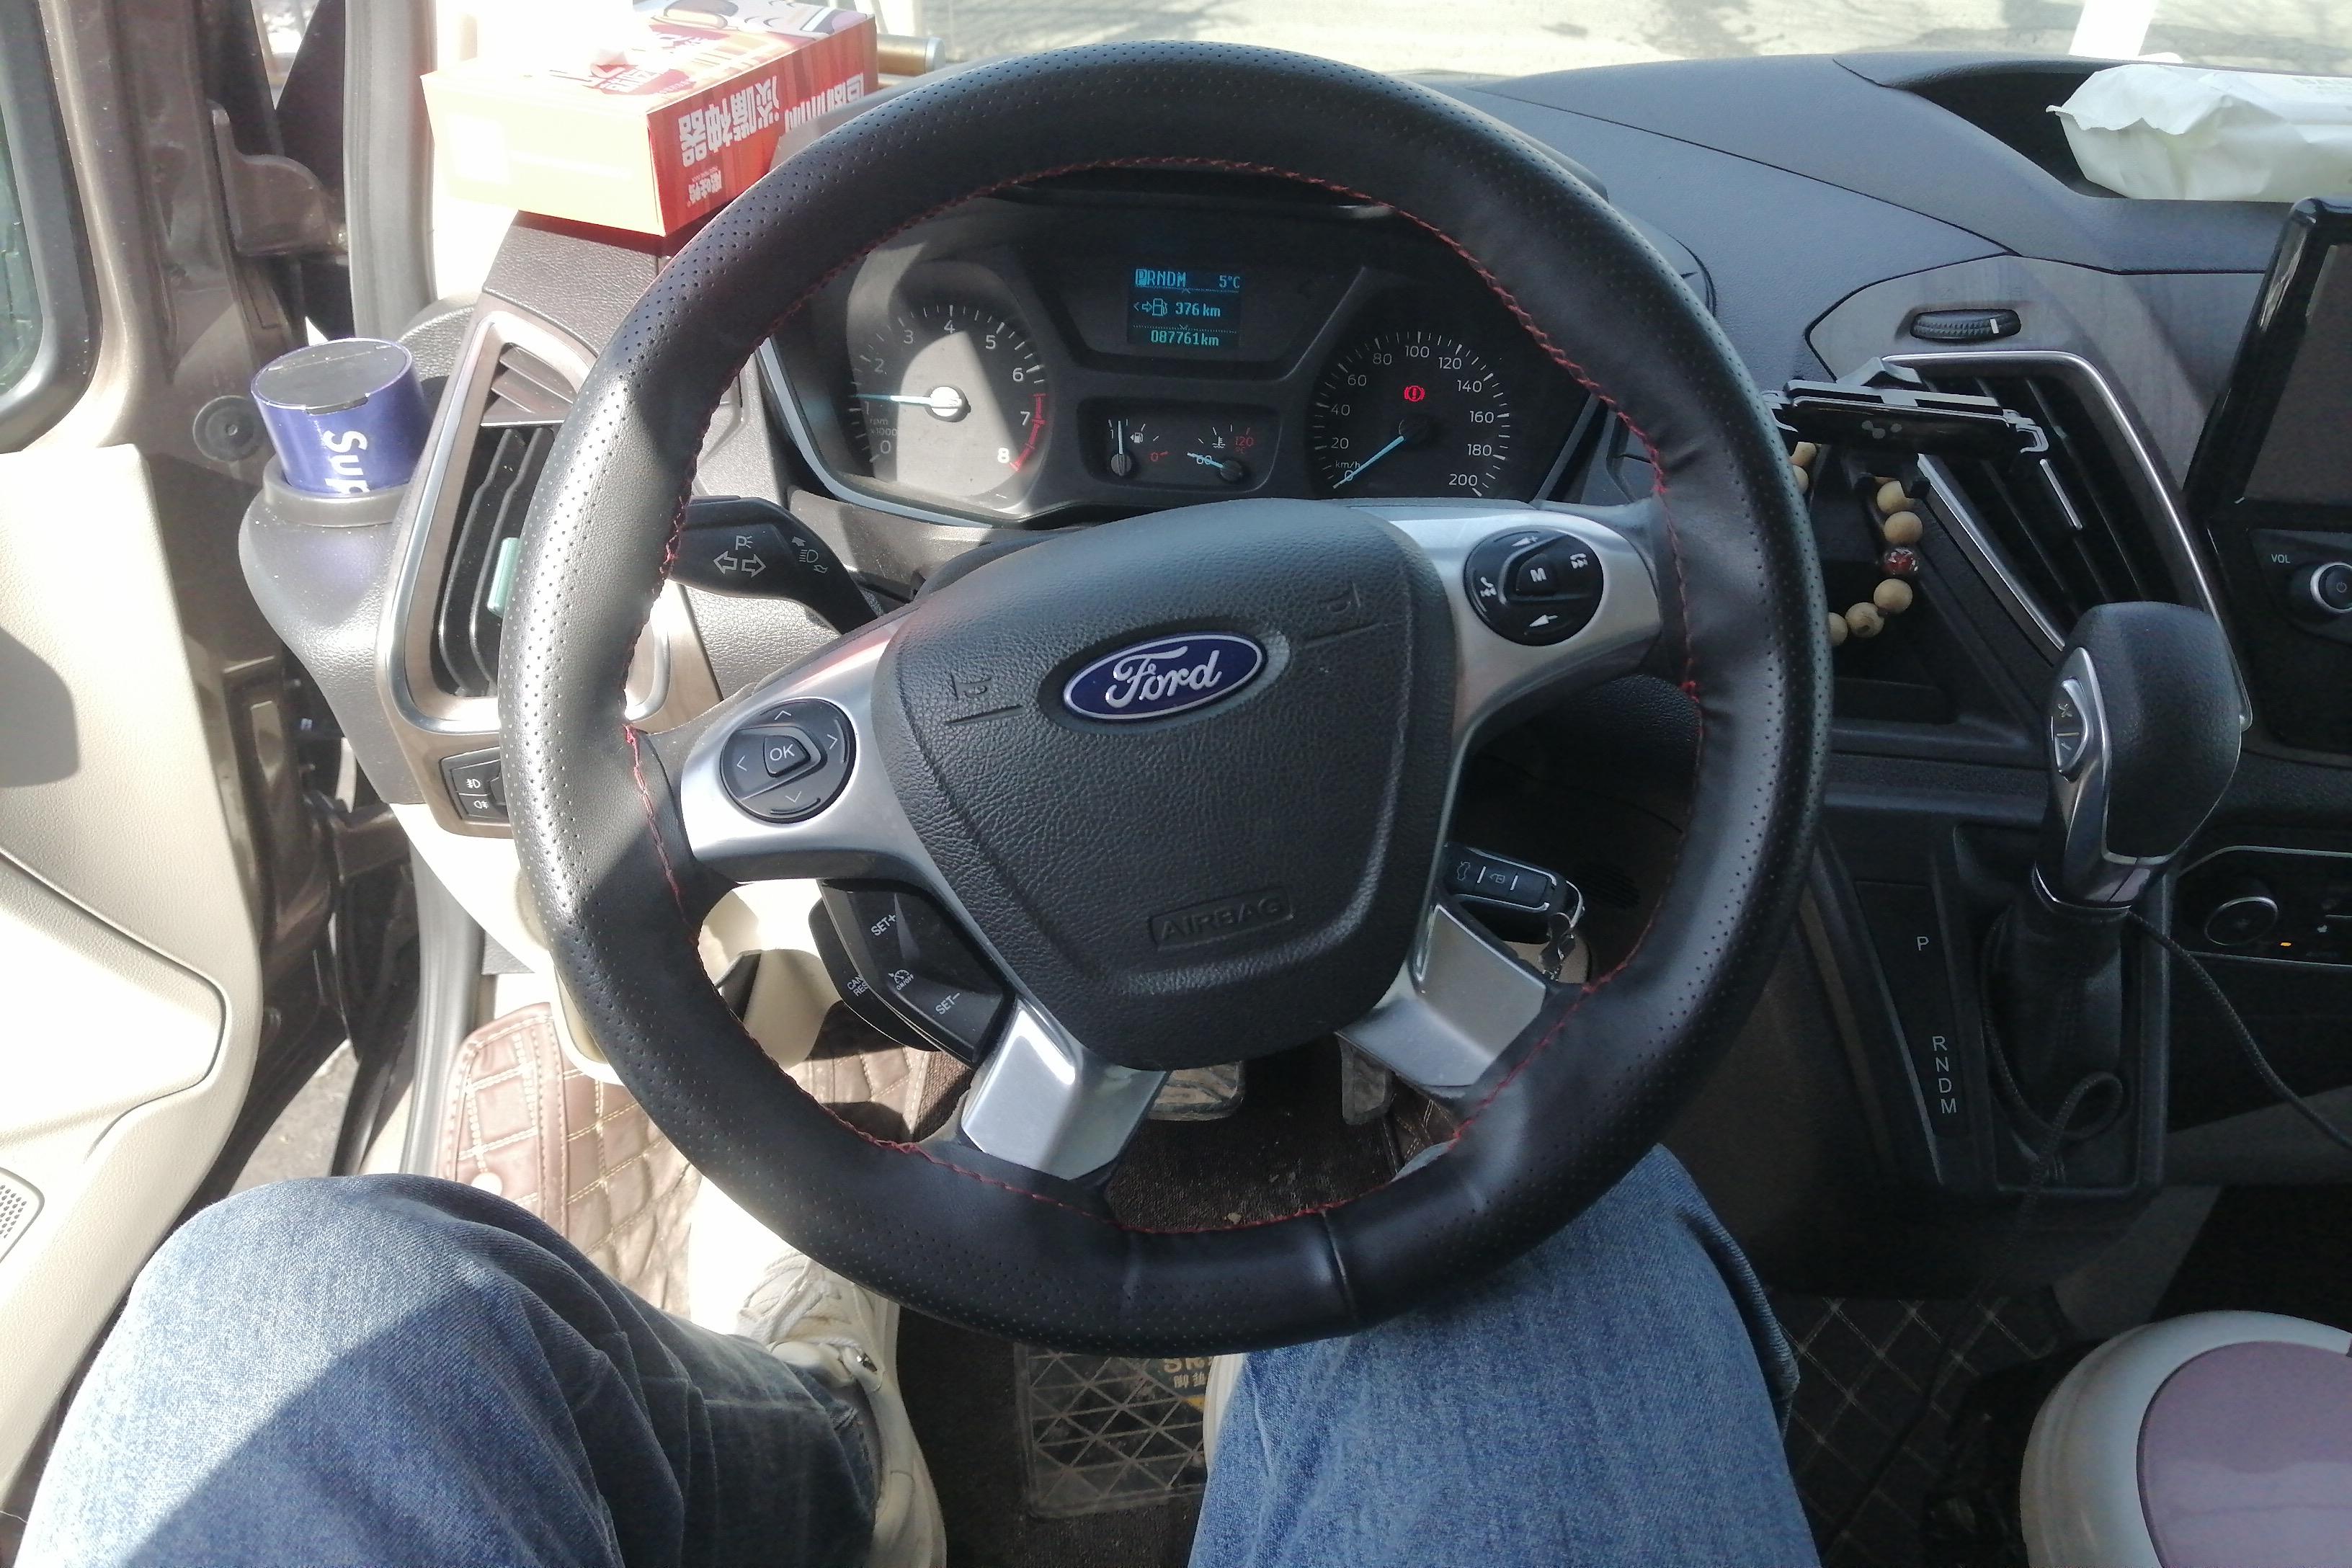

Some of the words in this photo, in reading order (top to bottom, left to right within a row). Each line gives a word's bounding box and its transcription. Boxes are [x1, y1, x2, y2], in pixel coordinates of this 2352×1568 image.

[1175, 302, 1200, 316] 376
[1203, 303, 1221, 317] km
[943, 320, 955, 334] 4
[904, 330, 914, 344] 3
[985, 335, 996, 349] 5
[1405, 345, 1430, 358] 100
[874, 359, 884, 373] 2
[1373, 353, 1392, 365] 80
[1438, 357, 1462, 370] 120
[1012, 368, 1024, 381] 6
[1348, 374, 1367, 386] 60
[1457, 379, 1482, 393] 140
[1331, 404, 1350, 416] 40
[1020, 411, 1030, 425] 7
[1470, 411, 1494, 424] 160
[880, 440, 891, 454] 0
[1331, 437, 1349, 450] 20
[1467, 444, 1492, 457] 180
[997, 447, 1010, 463] 8
[1335, 460, 1361, 469] km/h
[1448, 473, 1478, 486] 200
[2271, 553, 2291, 564] VOL
[1531, 568, 1547, 582] M
[1105, 645, 1222, 708] Ford
[770, 744, 795, 761] OK
[1161, 896, 1282, 937] AIRBAG
[1917, 936, 1929, 950] P
[1932, 1035, 1948, 1051] R
[1936, 1056, 1950, 1072] N
[1938, 1078, 1952, 1093] D
[1941, 1098, 1957, 1114] M
